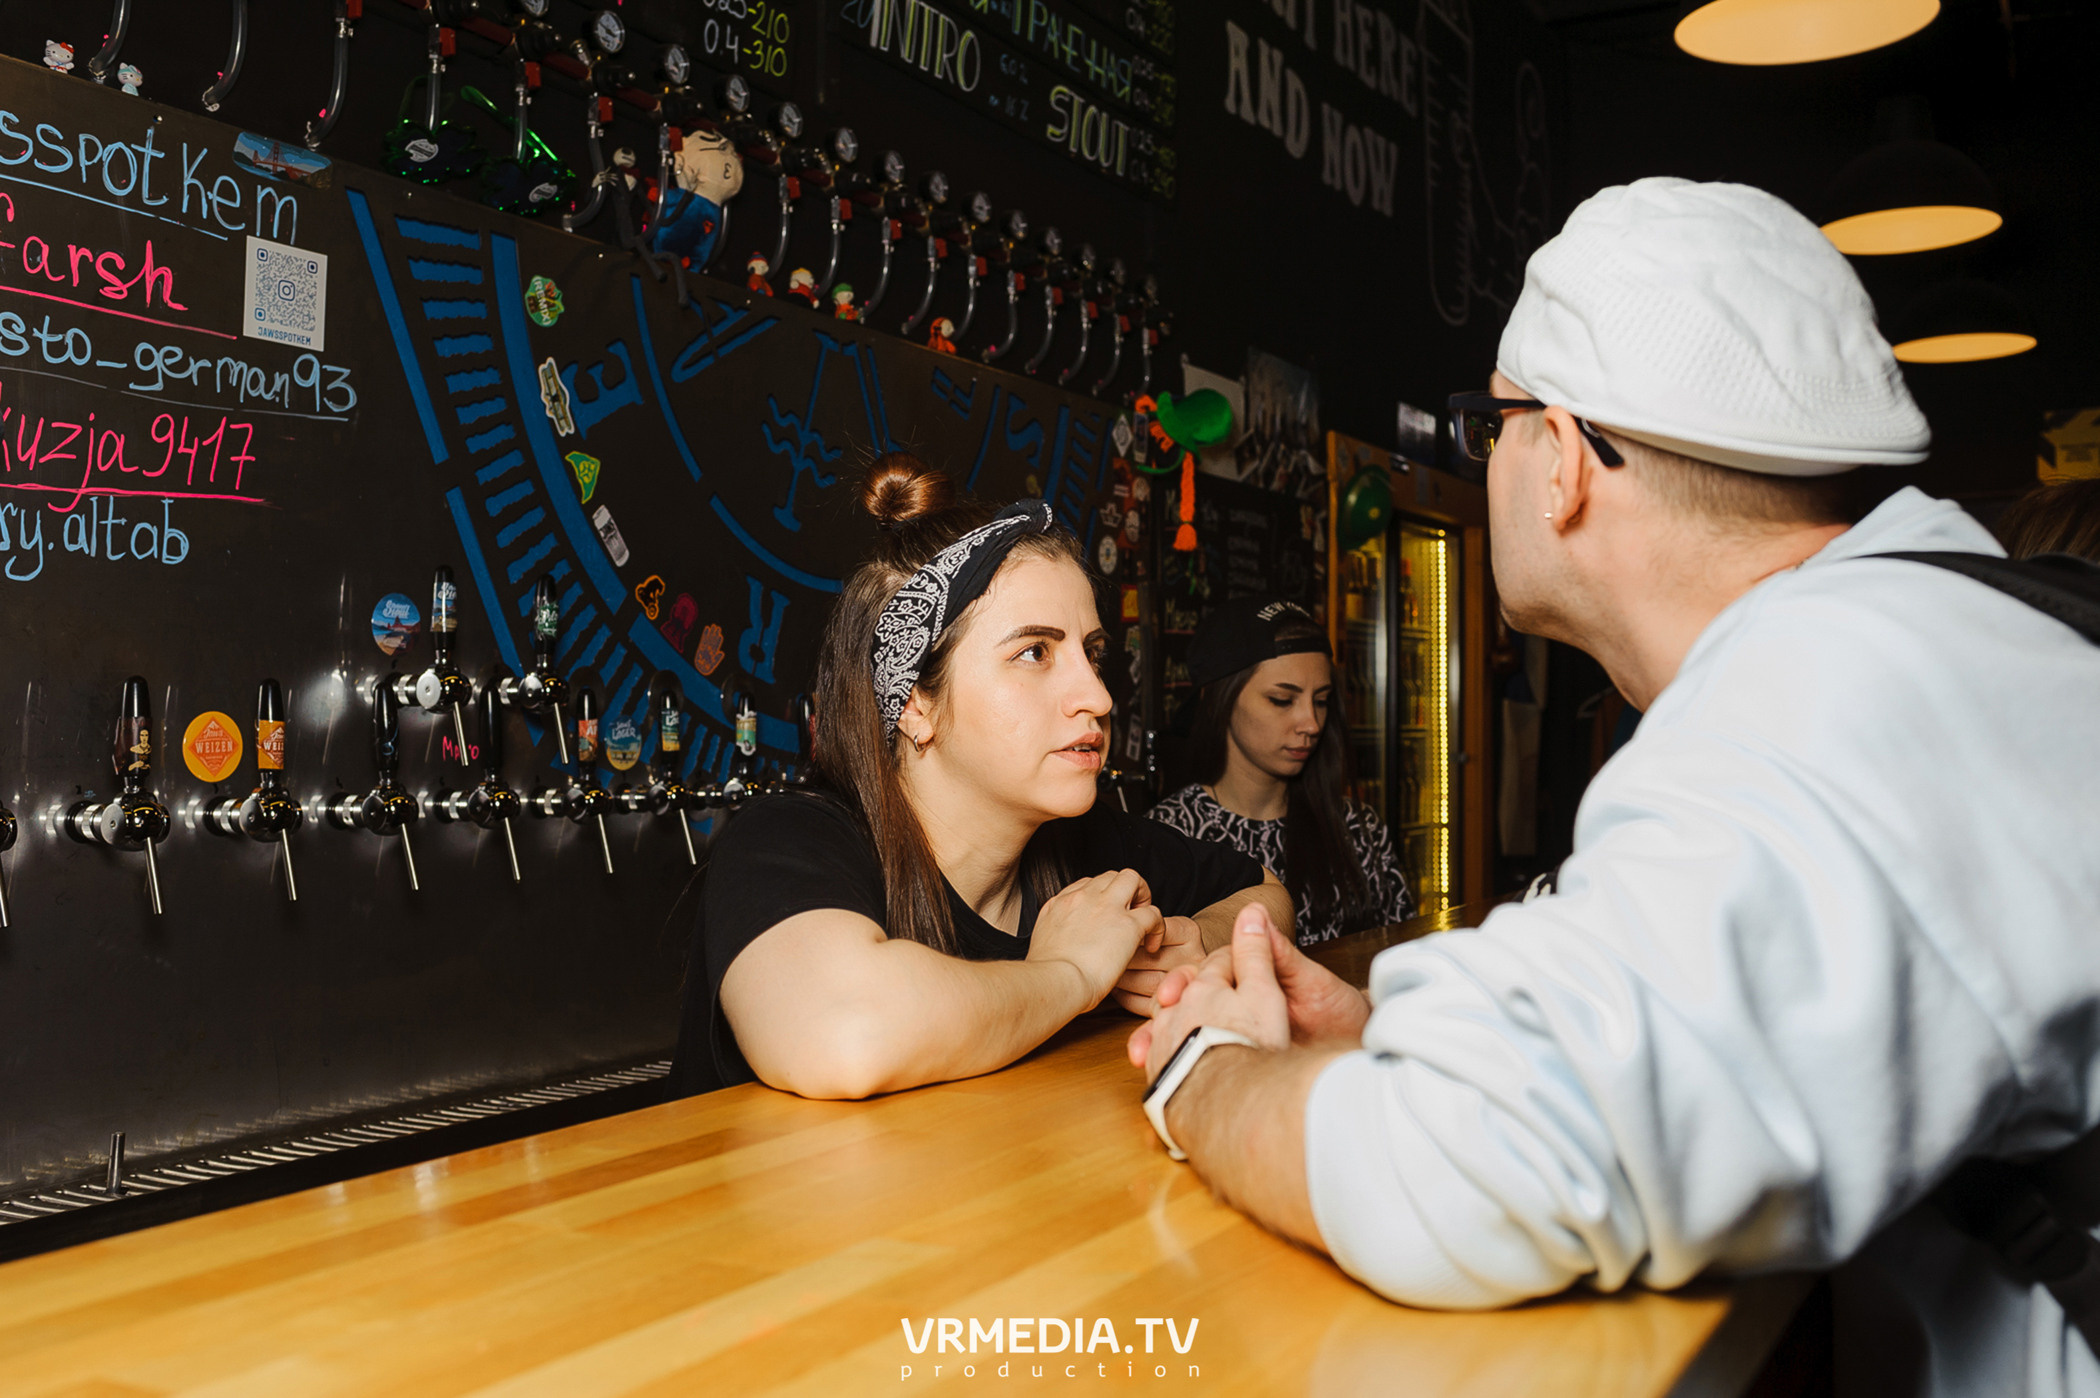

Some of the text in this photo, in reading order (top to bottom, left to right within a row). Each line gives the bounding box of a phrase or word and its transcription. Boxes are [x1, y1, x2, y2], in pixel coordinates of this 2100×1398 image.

[1333, 0, 1418, 118] HERE
[1046, 84, 1130, 177] STOUT
[1224, 20, 1311, 159] AND
[1321, 102, 1399, 218] NOW
[195, 741, 233, 753] WEIZEN
